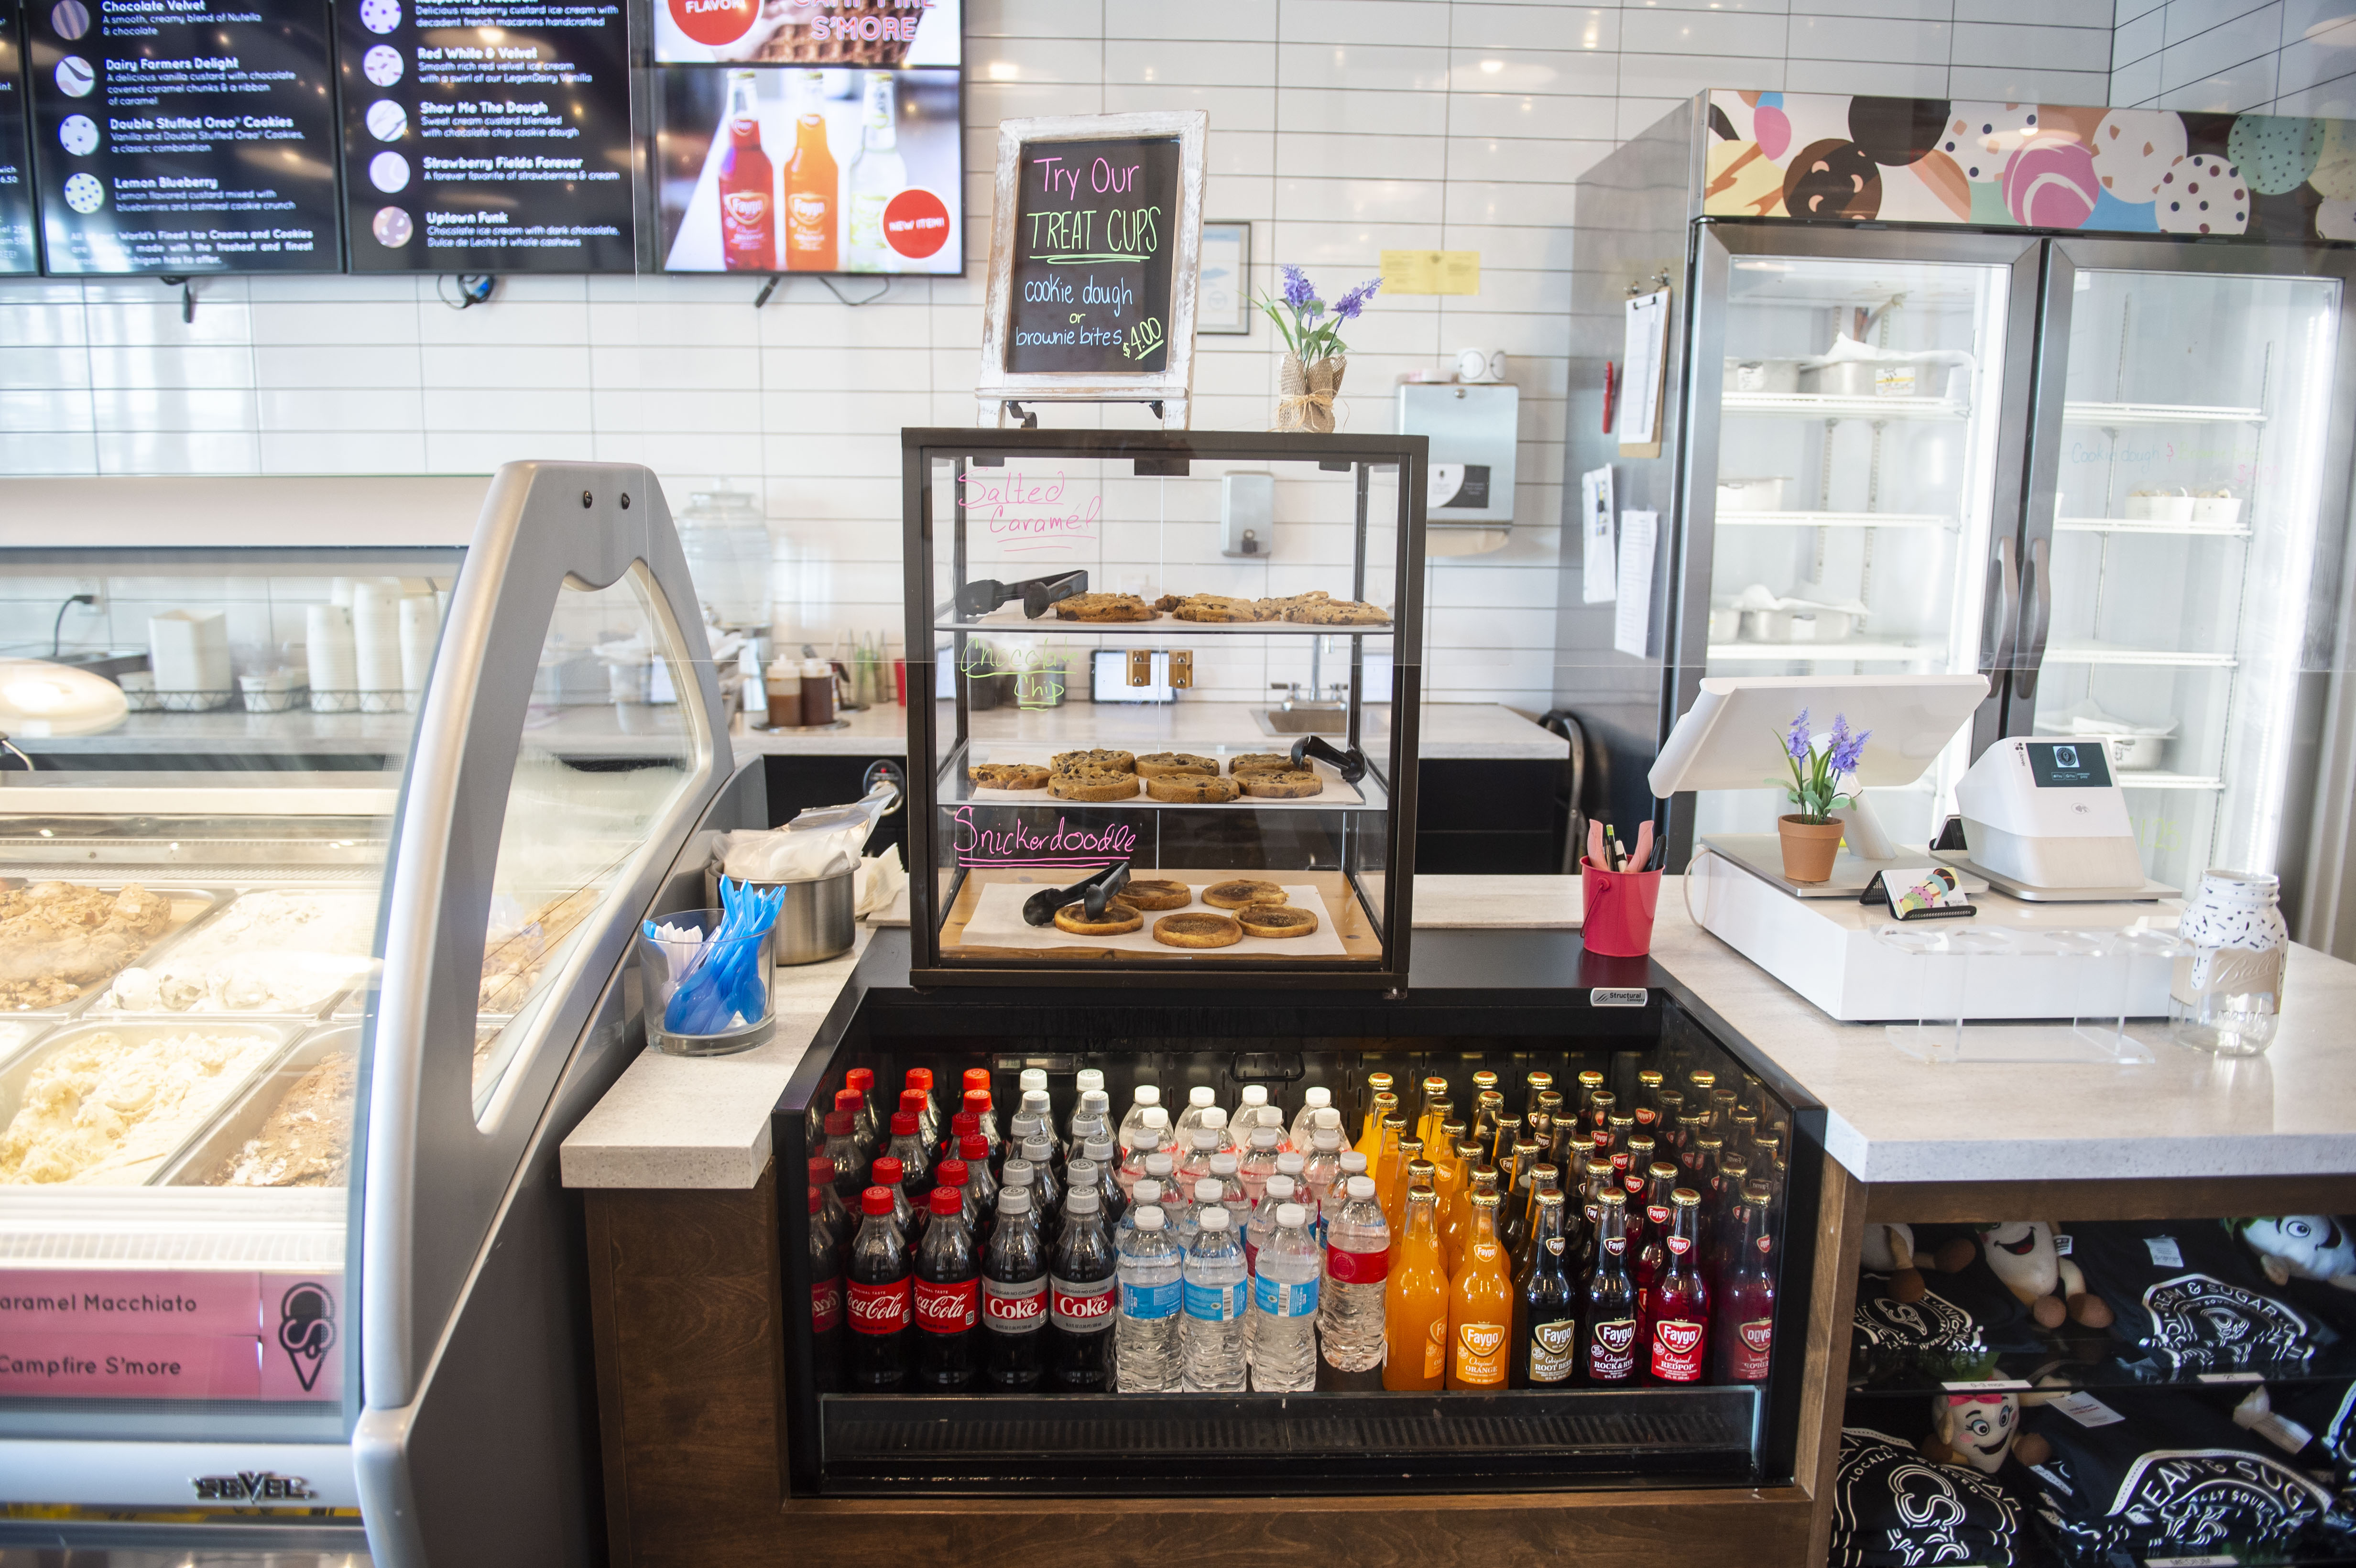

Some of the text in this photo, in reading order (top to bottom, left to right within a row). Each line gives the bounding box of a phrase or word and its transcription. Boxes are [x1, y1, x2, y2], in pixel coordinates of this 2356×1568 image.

[102, 0, 206, 12] Chocolate Velvet
[415, 5, 619, 17] Delicious raspberry custard ice cream with
[102, 15, 110, 23] A
[149, 14, 185, 24] creamy
[186, 13, 215, 22] blend
[216, 12, 227, 22] of
[227, 12, 262, 22] Nutella
[112, 26, 159, 35] chocolate
[417, 46, 443, 59] Red
[444, 46, 484, 60] White
[497, 46, 537, 59] Velvet
[105, 56, 239, 72] Dairy Farmers Delight
[418, 61, 575, 71] Smooth rich red velvet ice cream
[106, 70, 296, 82] A delicious vanilla custard with chocolate
[418, 73, 593, 85] with a swirl of our LegenDairy Vanilla
[419, 100, 549, 116] Show Me The Dough
[109, 117, 155, 130] Double
[155, 116, 203, 130] Stuffed
[242, 115, 294, 129] Cookies
[421, 127, 580, 139] with chocolate chip cookie dough
[423, 155, 584, 171] Strawberry Fields Forever
[113, 175, 218, 190] Lemon Blueberry
[1033, 156, 1140, 200] Try Our
[426, 210, 509, 226] Uptown Funk
[889, 219, 915, 231] NEW
[1026, 206, 1161, 252] TREAT CUPS
[1025, 273, 1133, 317] cookie dough
[1069, 312, 1086, 325] or
[1015, 326, 1123, 346] brownie bites
[958, 467, 1066, 509] Salted
[990, 495, 1102, 533] Caramel
[960, 636, 1079, 673] Chocolate
[1013, 675, 1065, 704] Chip
[953, 806, 1136, 855] Snickerdoodle
[1625, 1178, 1640, 1188] Faygo
[1649, 1208, 1666, 1219] Faygo
[1477, 1246, 1495, 1257] Faygo
[1608, 1241, 1625, 1251] Faygo
[1669, 1238, 1687, 1250] Faygo
[84, 1293, 197, 1312] Macchiato
[990, 1298, 1038, 1318] Coke
[1059, 1296, 1108, 1317] Coke
[1467, 1328, 1498, 1347] Faygo
[1544, 1327, 1571, 1344] Faygo
[1603, 1326, 1632, 1343] Faygo
[1664, 1325, 1696, 1342] Faygo
[1469, 1356, 1495, 1366] Original
[1545, 1352, 1568, 1364] Original
[1604, 1351, 1629, 1365] Original
[1664, 1353, 1692, 1365] Original
[0, 1354, 181, 1378] Campfire S'more
[1465, 1365, 1498, 1373] ORANGE
[1535, 1363, 1557, 1371] ROOT
[1660, 1361, 1693, 1371] REDPOP
[1849, 1450, 1899, 1482] LOCALLY
